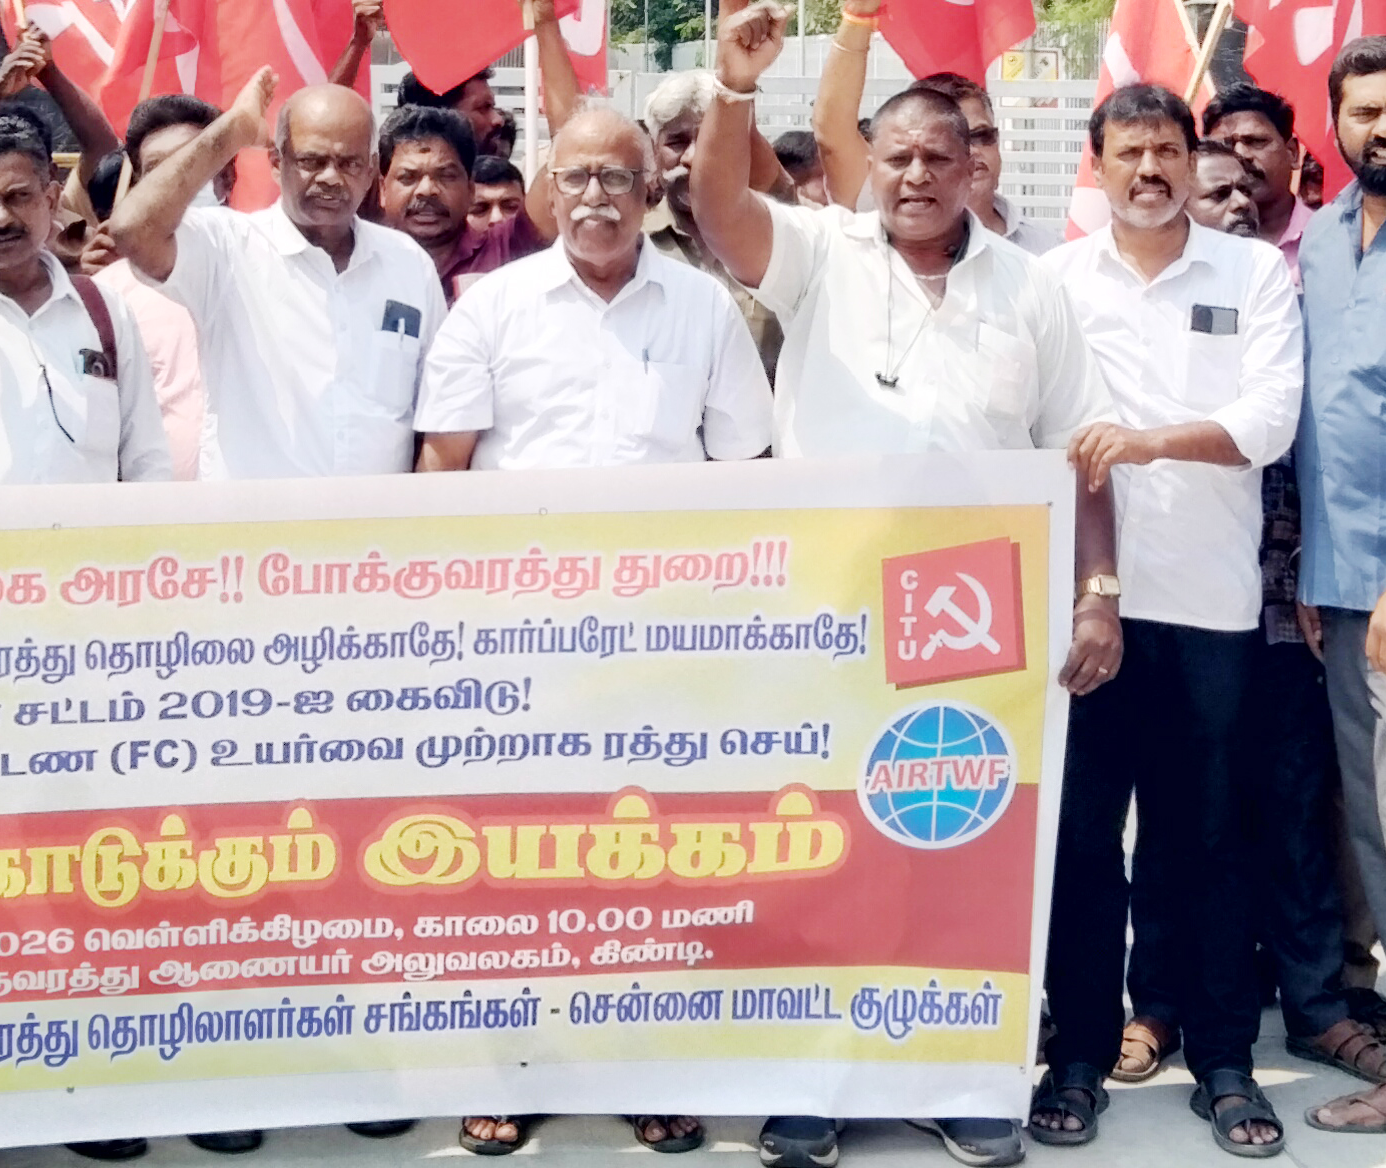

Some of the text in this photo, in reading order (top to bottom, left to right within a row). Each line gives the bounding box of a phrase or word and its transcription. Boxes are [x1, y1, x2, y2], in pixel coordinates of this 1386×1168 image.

[59, 555, 244, 607] அரசே!!
[258, 547, 602, 599] போக்குவரத்து
[612, 540, 788, 597] துறை!!!
[898, 569, 918, 661] CITU
[85, 631, 255, 680] தொழிலை
[263, 621, 465, 674] அழிக்காதே!
[645, 613, 867, 662] மயமாக்காதே!
[13, 690, 145, 726] சட்டம்
[159, 687, 335, 721] 2019-ஐ
[346, 677, 532, 715] கைவிடு!
[111, 738, 197, 775] (FC)
[211, 733, 404, 767] உயர்வை
[416, 727, 592, 769] முற்றாக
[603, 725, 708, 767] ரத்து
[720, 722, 831, 760] செய்!
[869, 757, 1008, 792] AIRTWF
[363, 791, 844, 887] இயக்கம்
[84, 913, 405, 953] வெள்ளிக்கிழமை,
[413, 909, 539, 939] காலை
[548, 906, 652, 934] 10.00
[661, 899, 755, 929] மணி
[149, 947, 352, 989] ஆணையர்
[361, 942, 581, 981] அலுவலகம்,
[589, 938, 714, 966] கிண்டி.
[88, 995, 355, 1062] தொழிலாளர்கள்
[364, 987, 541, 1033] சங்கங்கள்
[569, 982, 724, 1025] சென்னை
[732, 983, 842, 1021] மாவட்ட
[850, 979, 1002, 1040] குழுக்கள்
